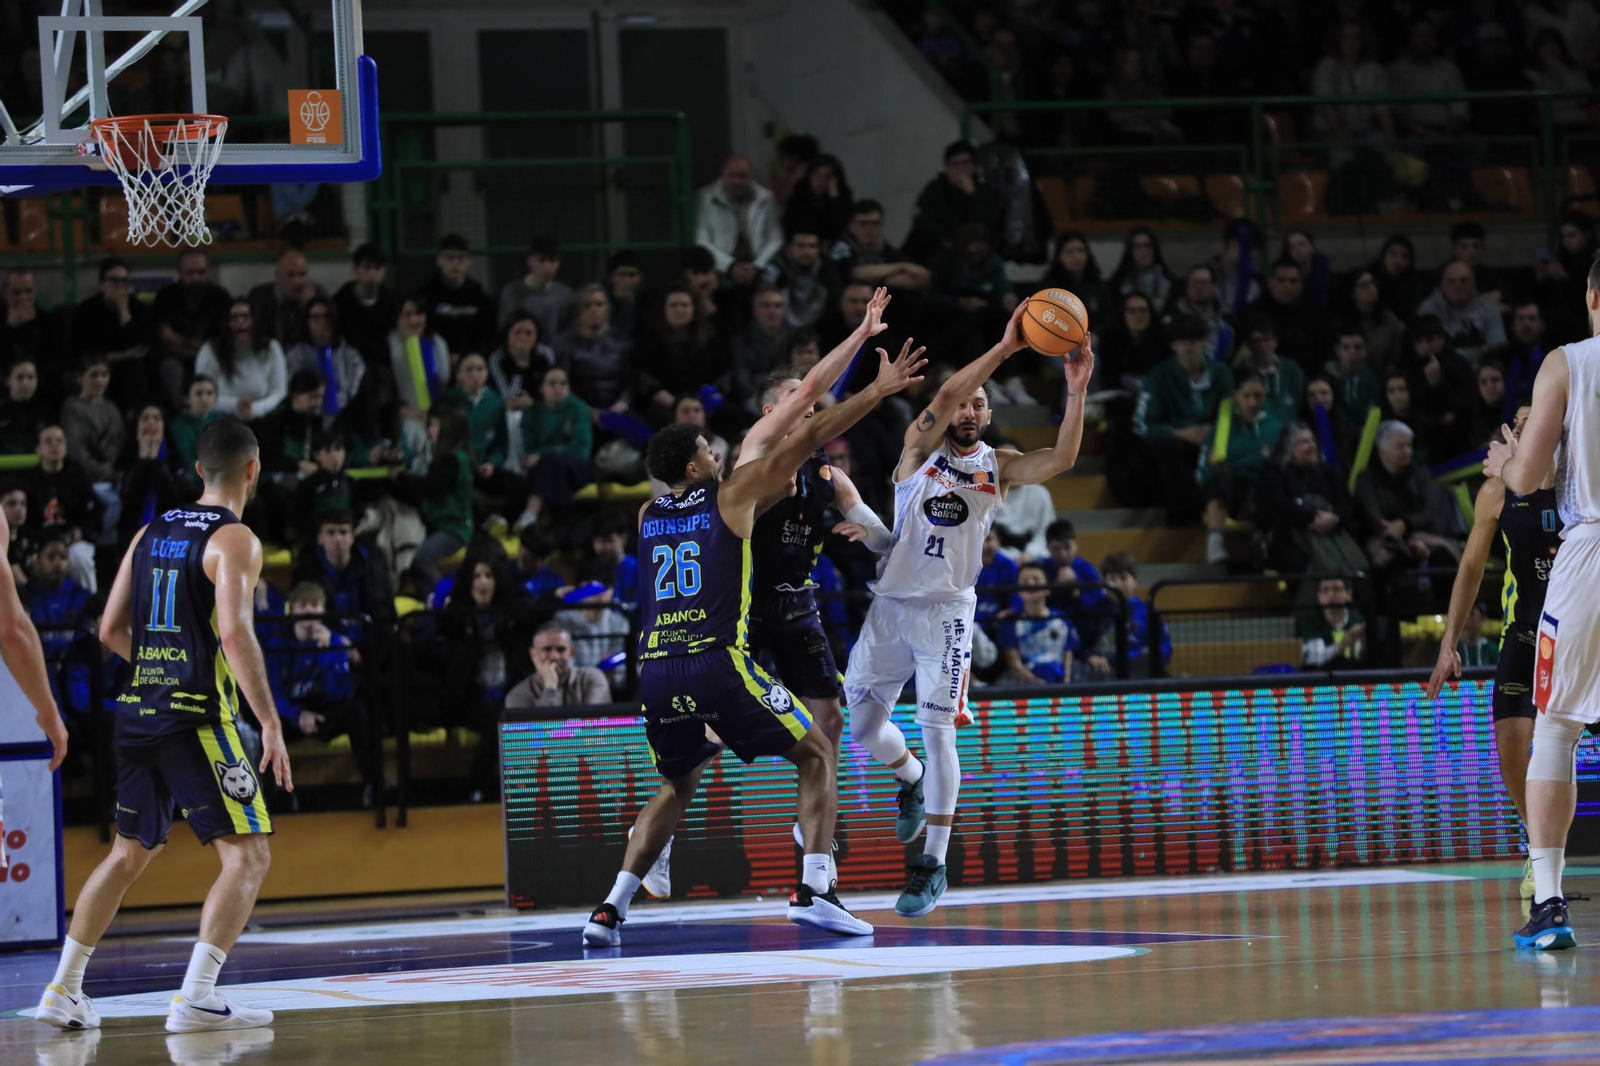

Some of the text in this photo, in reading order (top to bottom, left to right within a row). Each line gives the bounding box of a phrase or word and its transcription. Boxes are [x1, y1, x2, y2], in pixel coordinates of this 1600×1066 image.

[184, 520, 210, 531] booking
[643, 513, 711, 539] OGUNSIPE
[151, 535, 190, 559] LÓPEZ
[924, 534, 945, 559] 21
[652, 540, 702, 602] 26
[145, 567, 181, 633] 11
[655, 608, 707, 627] ABANCA
[137, 645, 188, 662] ABANCA
[139, 676, 180, 686] DE GALICIA
[141, 667, 165, 676] XUNTA
[949, 648, 962, 699] MADRID
